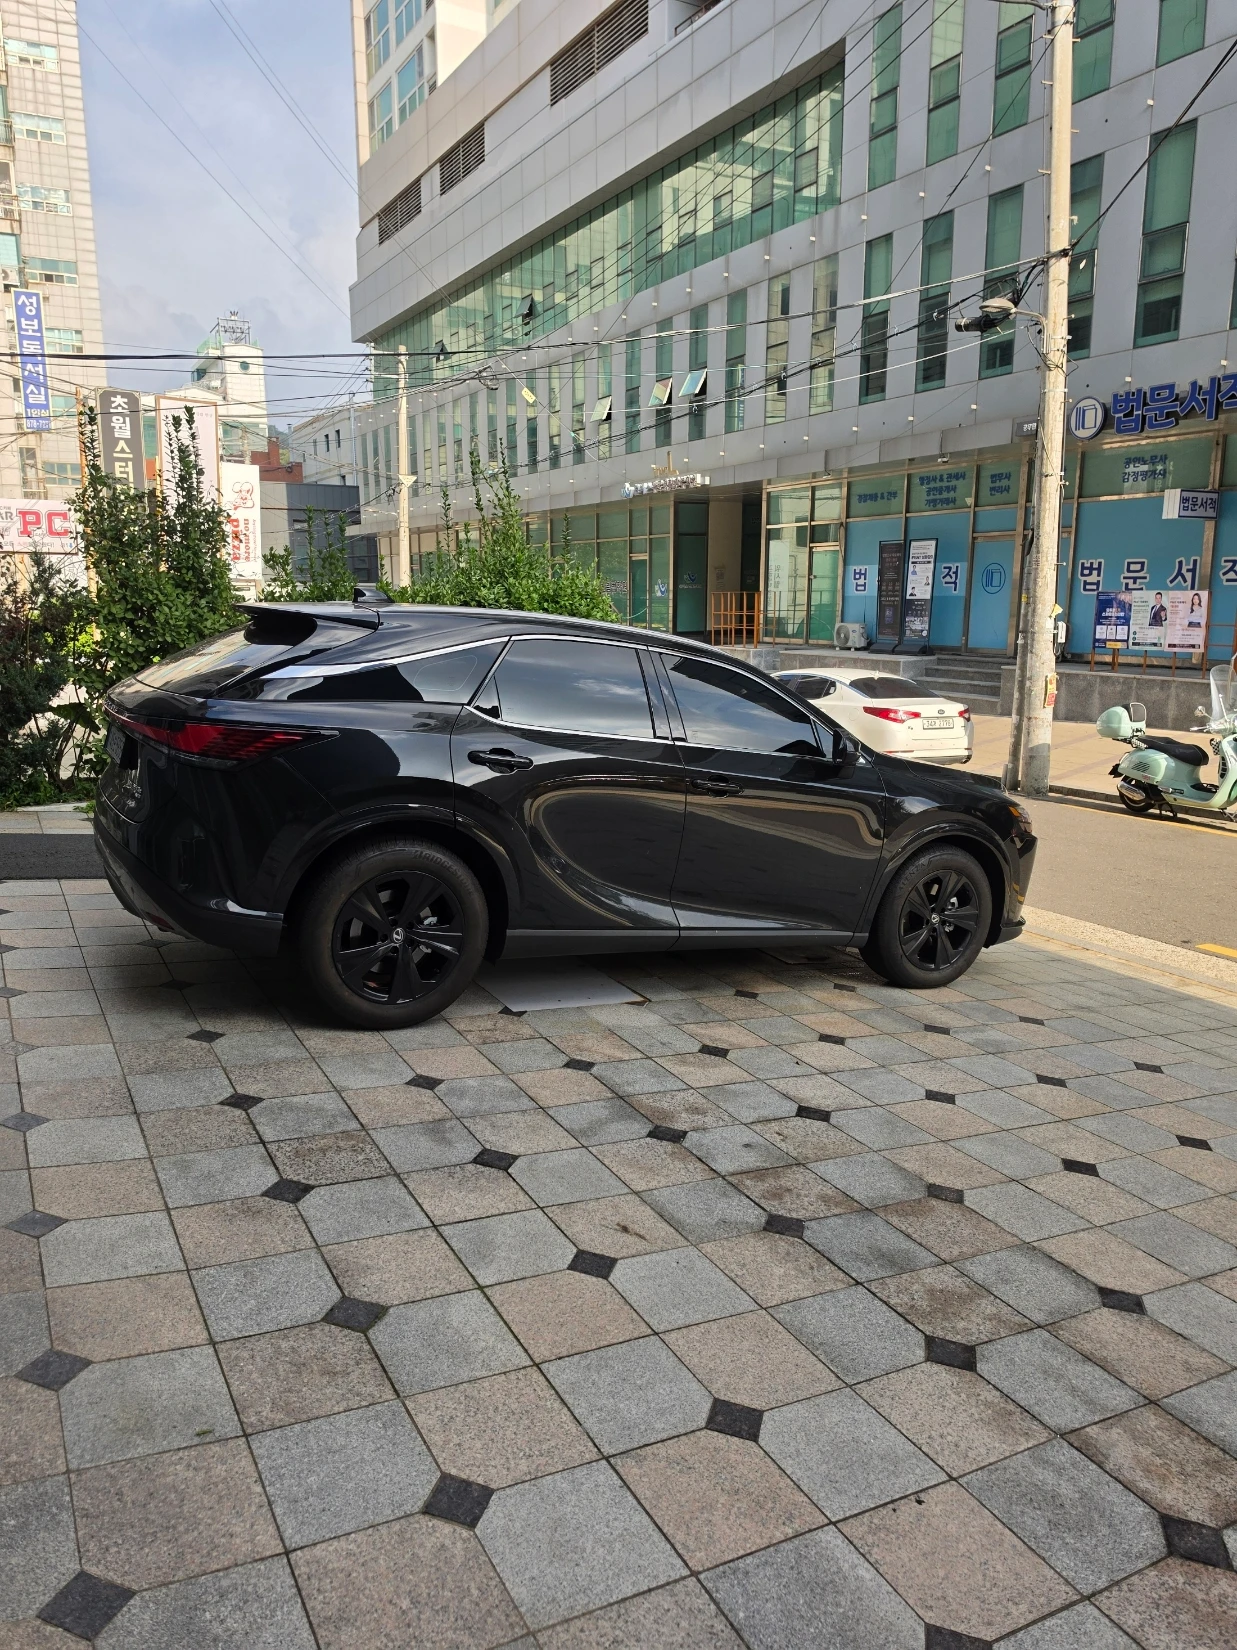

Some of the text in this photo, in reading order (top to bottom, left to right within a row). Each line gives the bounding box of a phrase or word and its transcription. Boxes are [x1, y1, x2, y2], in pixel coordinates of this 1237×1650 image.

[17, 294, 47, 405] 성보독서실
[1123, 453, 1168, 469] 공인노무사
[990, 471, 1012, 484] 법무사
[1122, 468, 1167, 483] 감정평가사
[925, 485, 957, 497] 공인중개사
[989, 484, 1011, 497] 변리사
[1181, 493, 1217, 514] 법문서적
[17, 509, 70, 538] PC
[244, 518, 250, 532] no
